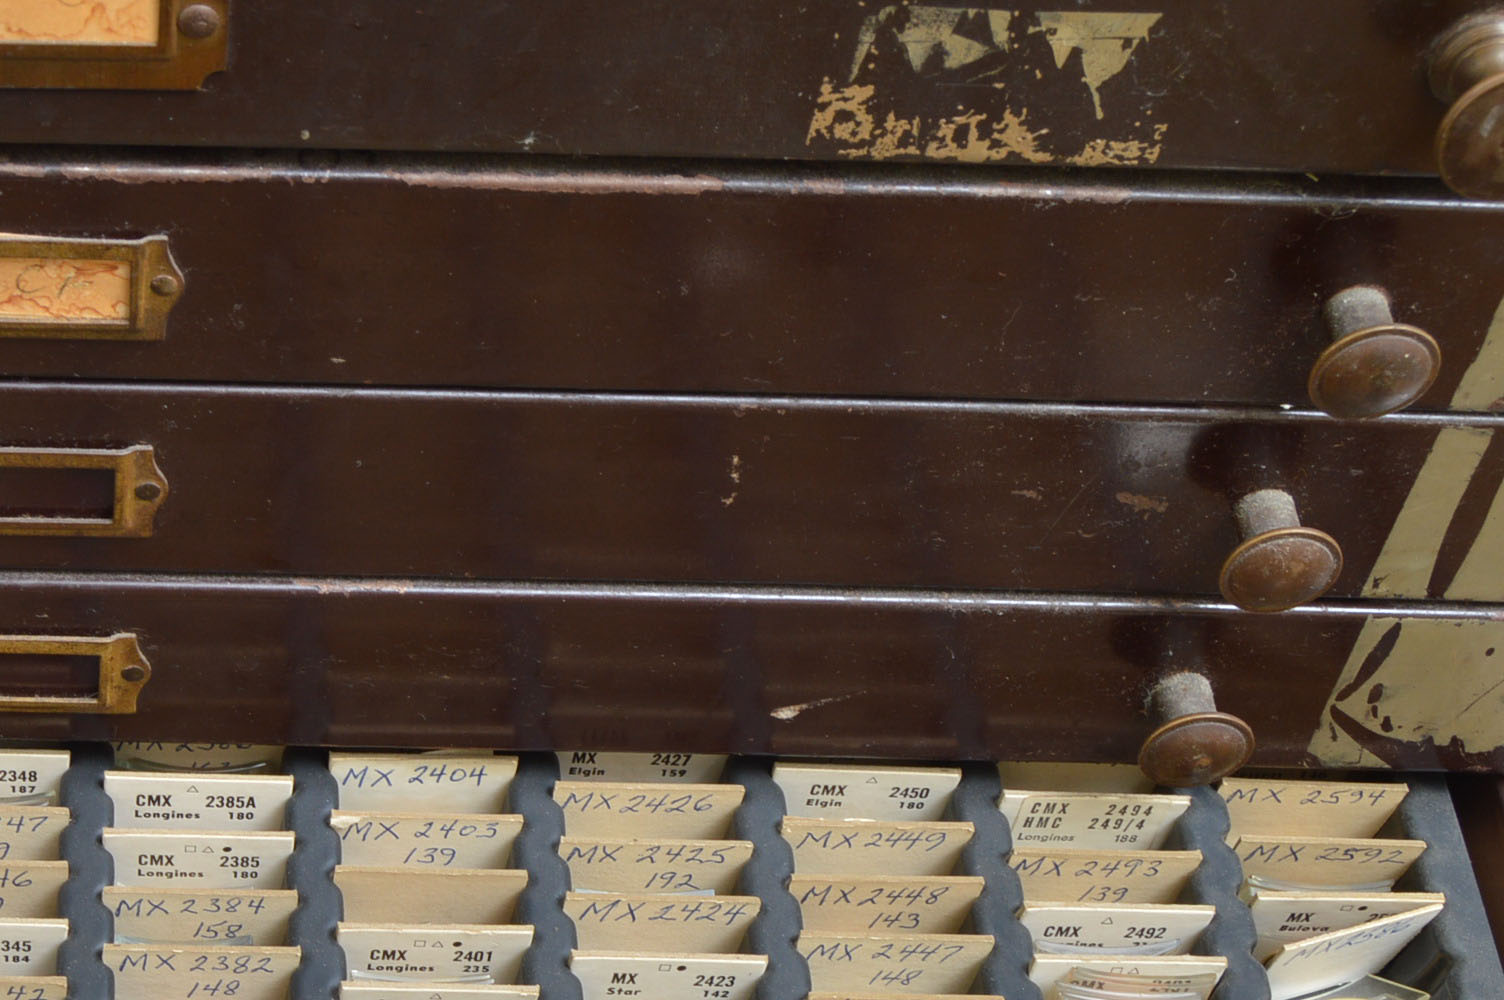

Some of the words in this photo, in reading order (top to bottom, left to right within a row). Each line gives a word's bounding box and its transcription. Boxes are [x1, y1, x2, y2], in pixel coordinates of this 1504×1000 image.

[341, 765, 394, 789] MX
[407, 763, 488, 787] 2404
[809, 784, 848, 797] CMX
[888, 786, 931, 799] 2450
[1226, 788, 1282, 804] MX
[135, 794, 172, 807] CMX
[205, 795, 256, 809] 2385A
[805, 798, 842, 809] Elgin
[899, 801, 925, 810] 180
[134, 809, 201, 821] Longines
[228, 811, 255, 821] 180
[1030, 802, 1071, 815] CMX
[1104, 803, 1154, 817] 2494
[1022, 816, 1063, 829] HMC
[1087, 817, 1146, 833] 249/4
[1016, 832, 1075, 843] Longines
[1114, 834, 1139, 844] 188
[801, 886, 859, 905] MX
[862, 887, 951, 906] 2448
[868, 911, 921, 930] 143
[3, 954, 30, 963] 184
[369, 949, 408, 961] CMX
[452, 950, 493, 963] 2401
[366, 963, 435, 974] Longines
[463, 965, 490, 973] 235
[610, 972, 638, 985] MX
[693, 974, 736, 988] 2423
[606, 987, 642, 996] Star
[703, 990, 730, 999] 142
